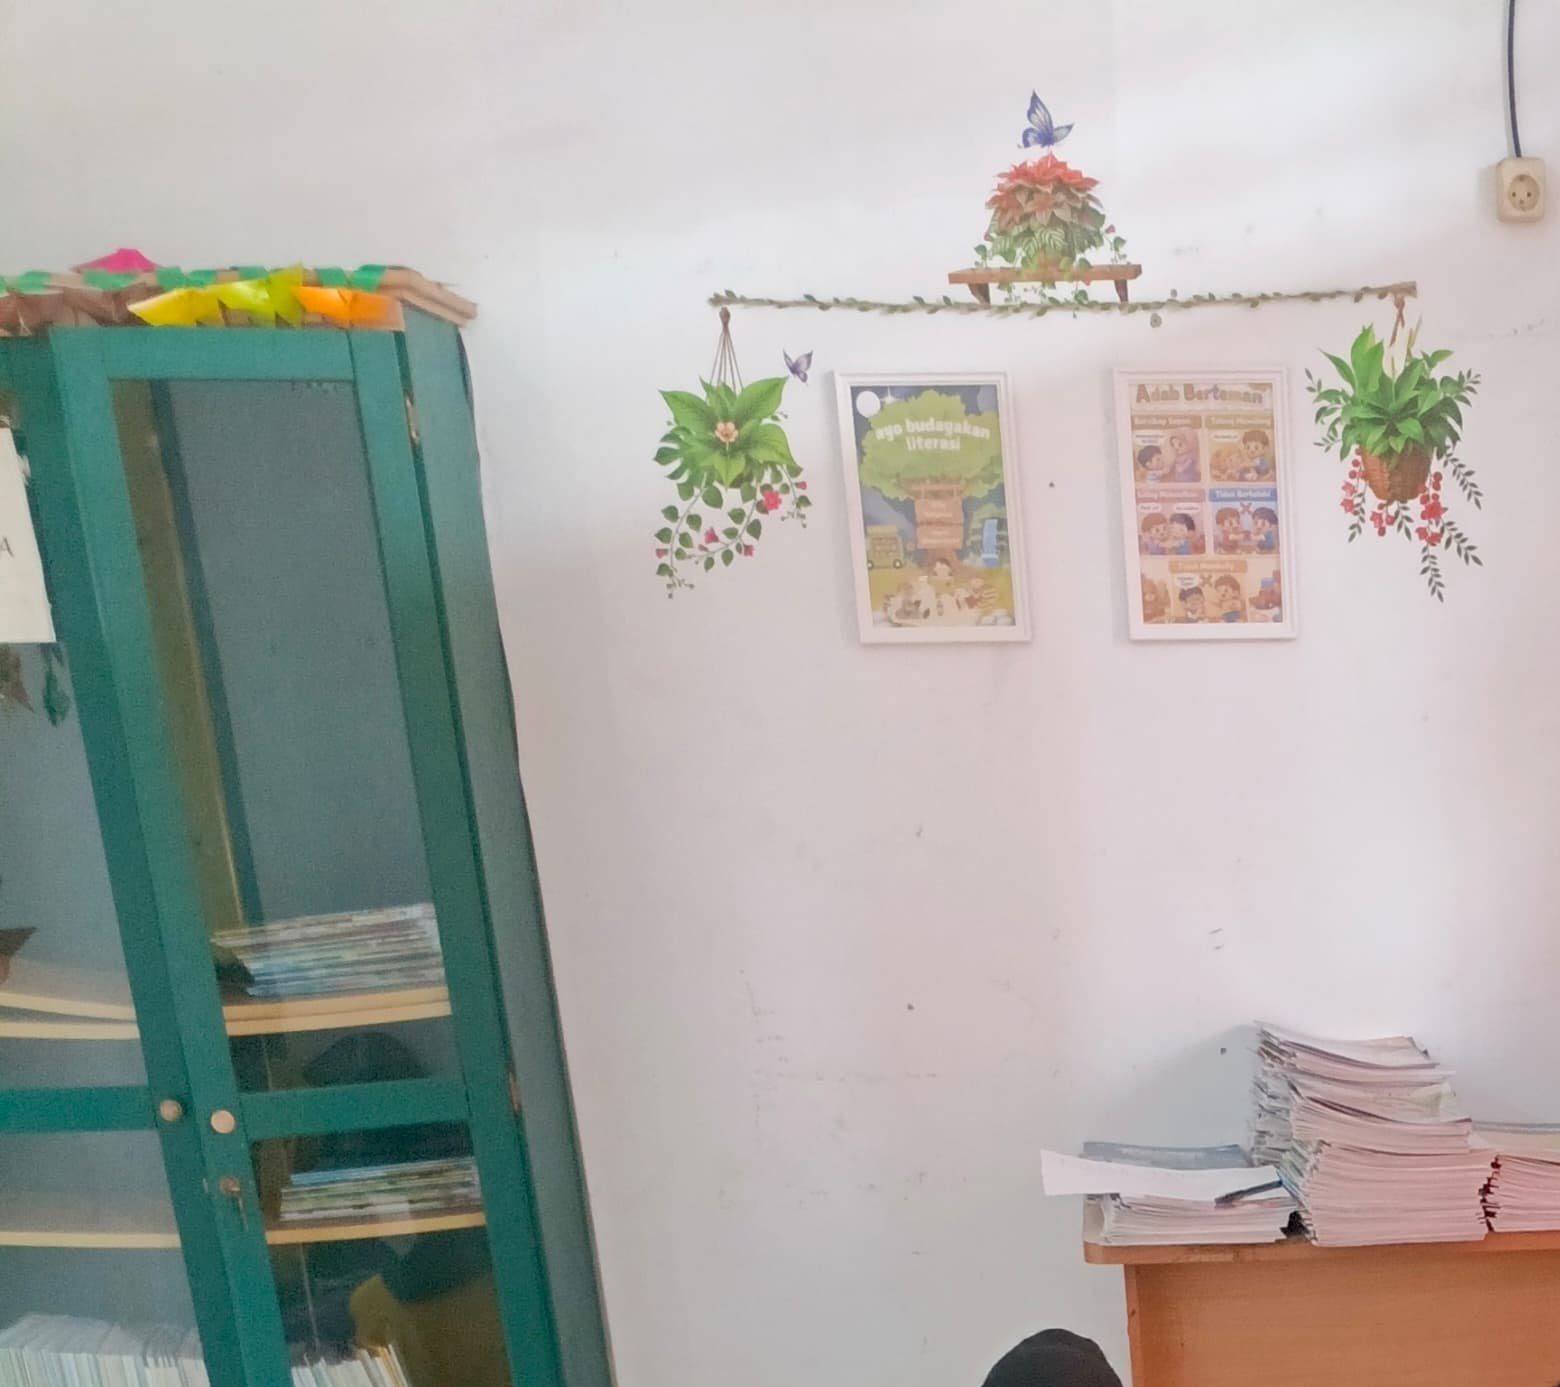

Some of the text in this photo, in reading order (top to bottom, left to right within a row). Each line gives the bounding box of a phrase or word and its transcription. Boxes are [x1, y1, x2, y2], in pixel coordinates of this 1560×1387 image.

[1136, 383, 1264, 404] Adab Berteman
[875, 417, 991, 441] ayo budayakan
[905, 435, 961, 451] literasi
